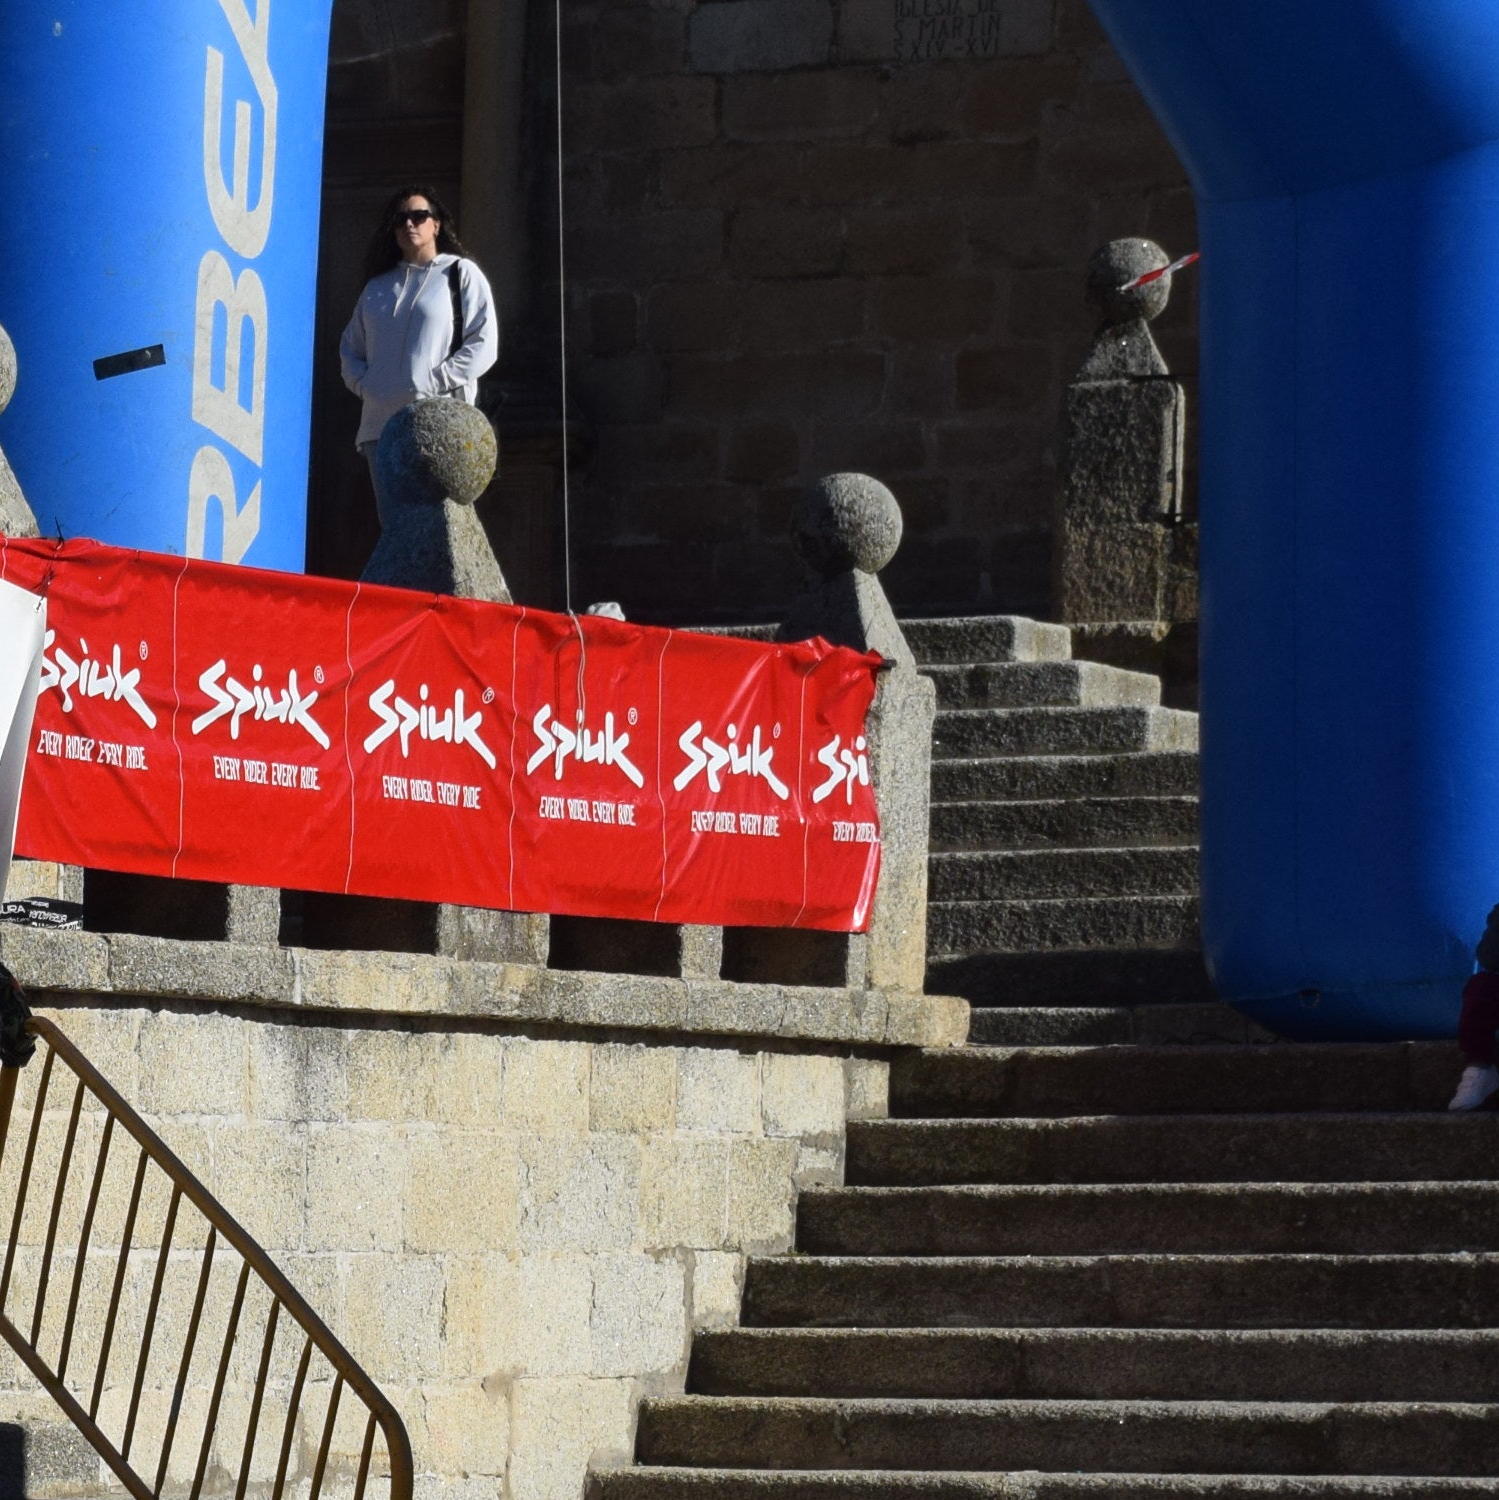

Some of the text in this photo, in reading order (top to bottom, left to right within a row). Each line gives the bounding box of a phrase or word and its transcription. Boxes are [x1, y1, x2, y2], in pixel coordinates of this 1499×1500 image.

[191, 659, 330, 750] Spiuk
[363, 679, 496, 770] Spiuk
[37, 729, 63, 758] EVERY
[214, 755, 242, 783] EVERY
[271, 763, 298, 789] EVERY
[812, 734, 869, 805] Spi
[382, 776, 408, 801] EVERY
[437, 782, 461, 807] EVERY
[539, 795, 565, 821] EVERY
[593, 801, 616, 825] EVERY
[833, 821, 854, 842] EVERY
